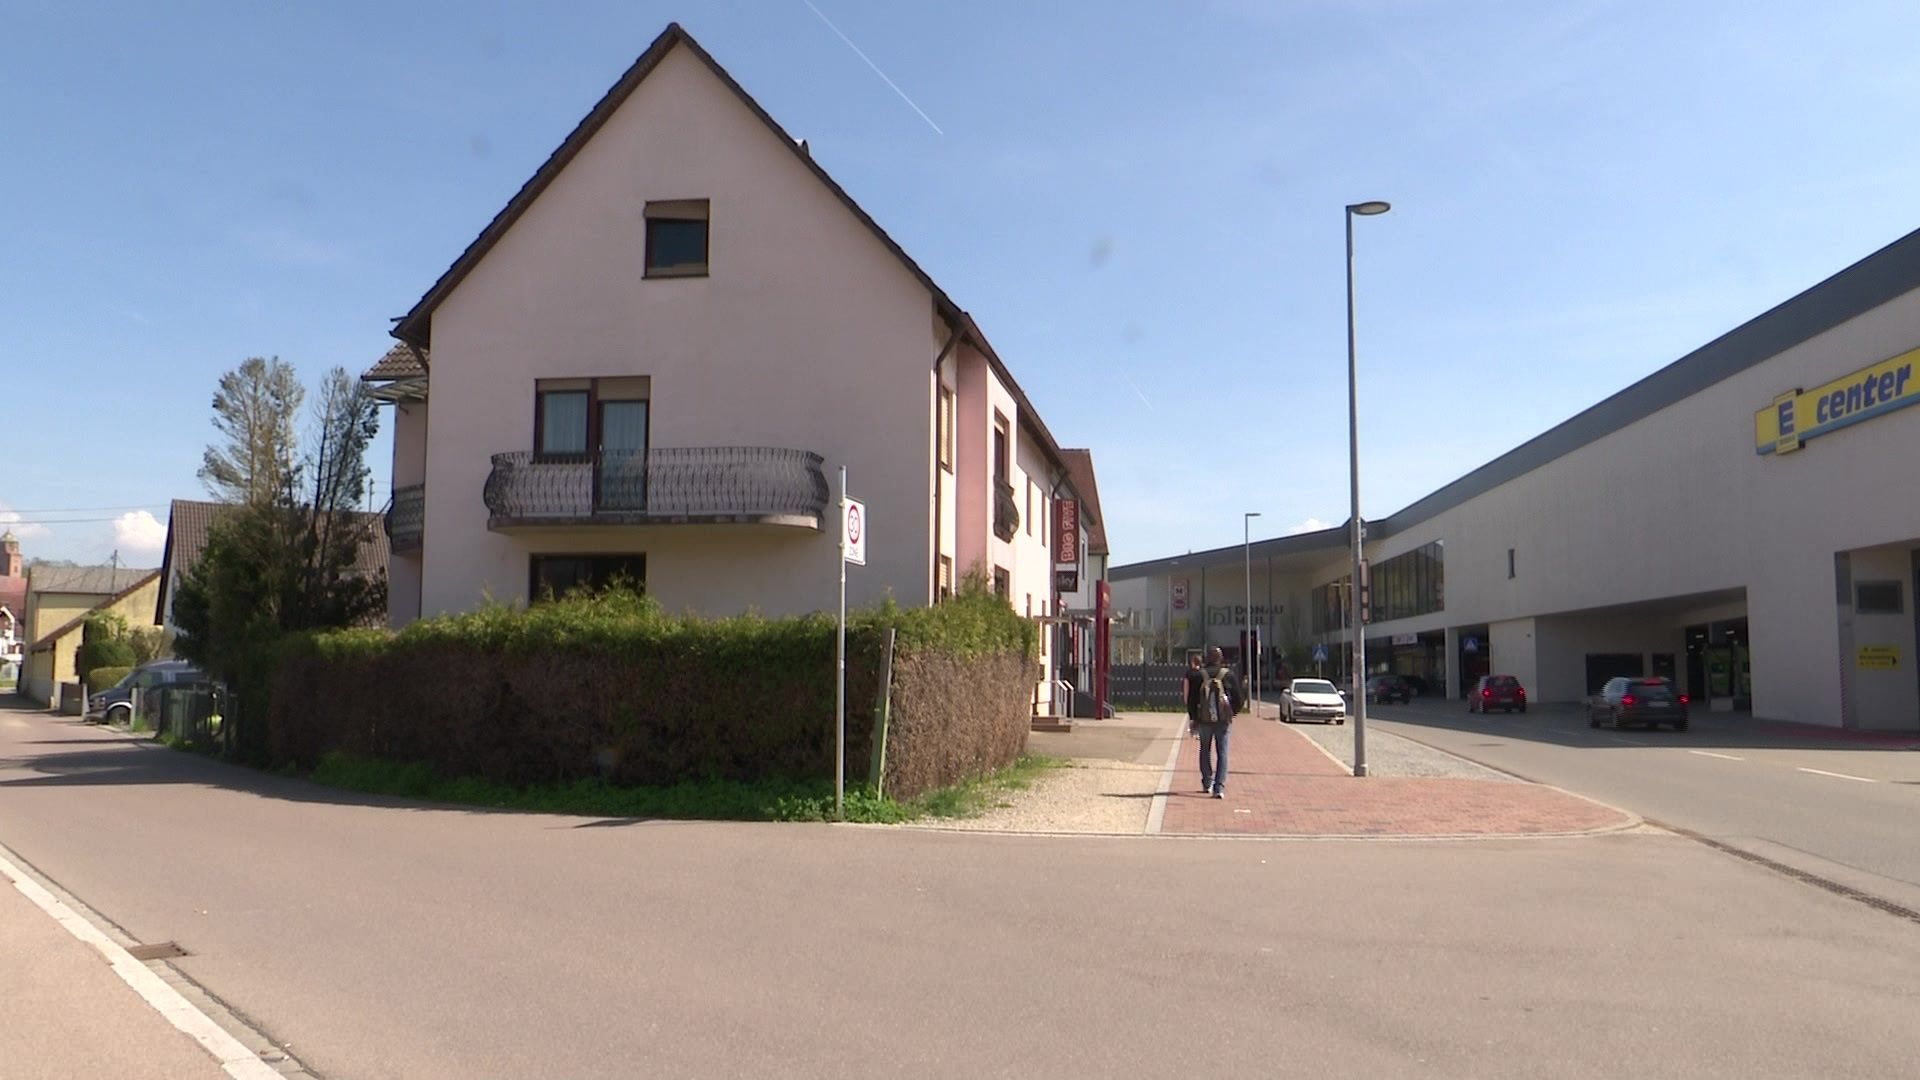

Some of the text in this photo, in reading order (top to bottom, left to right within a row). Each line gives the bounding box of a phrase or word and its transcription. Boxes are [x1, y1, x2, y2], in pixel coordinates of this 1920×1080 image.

[1778, 363, 1911, 436] E center
[1061, 500, 1075, 562] BIG FIVE
